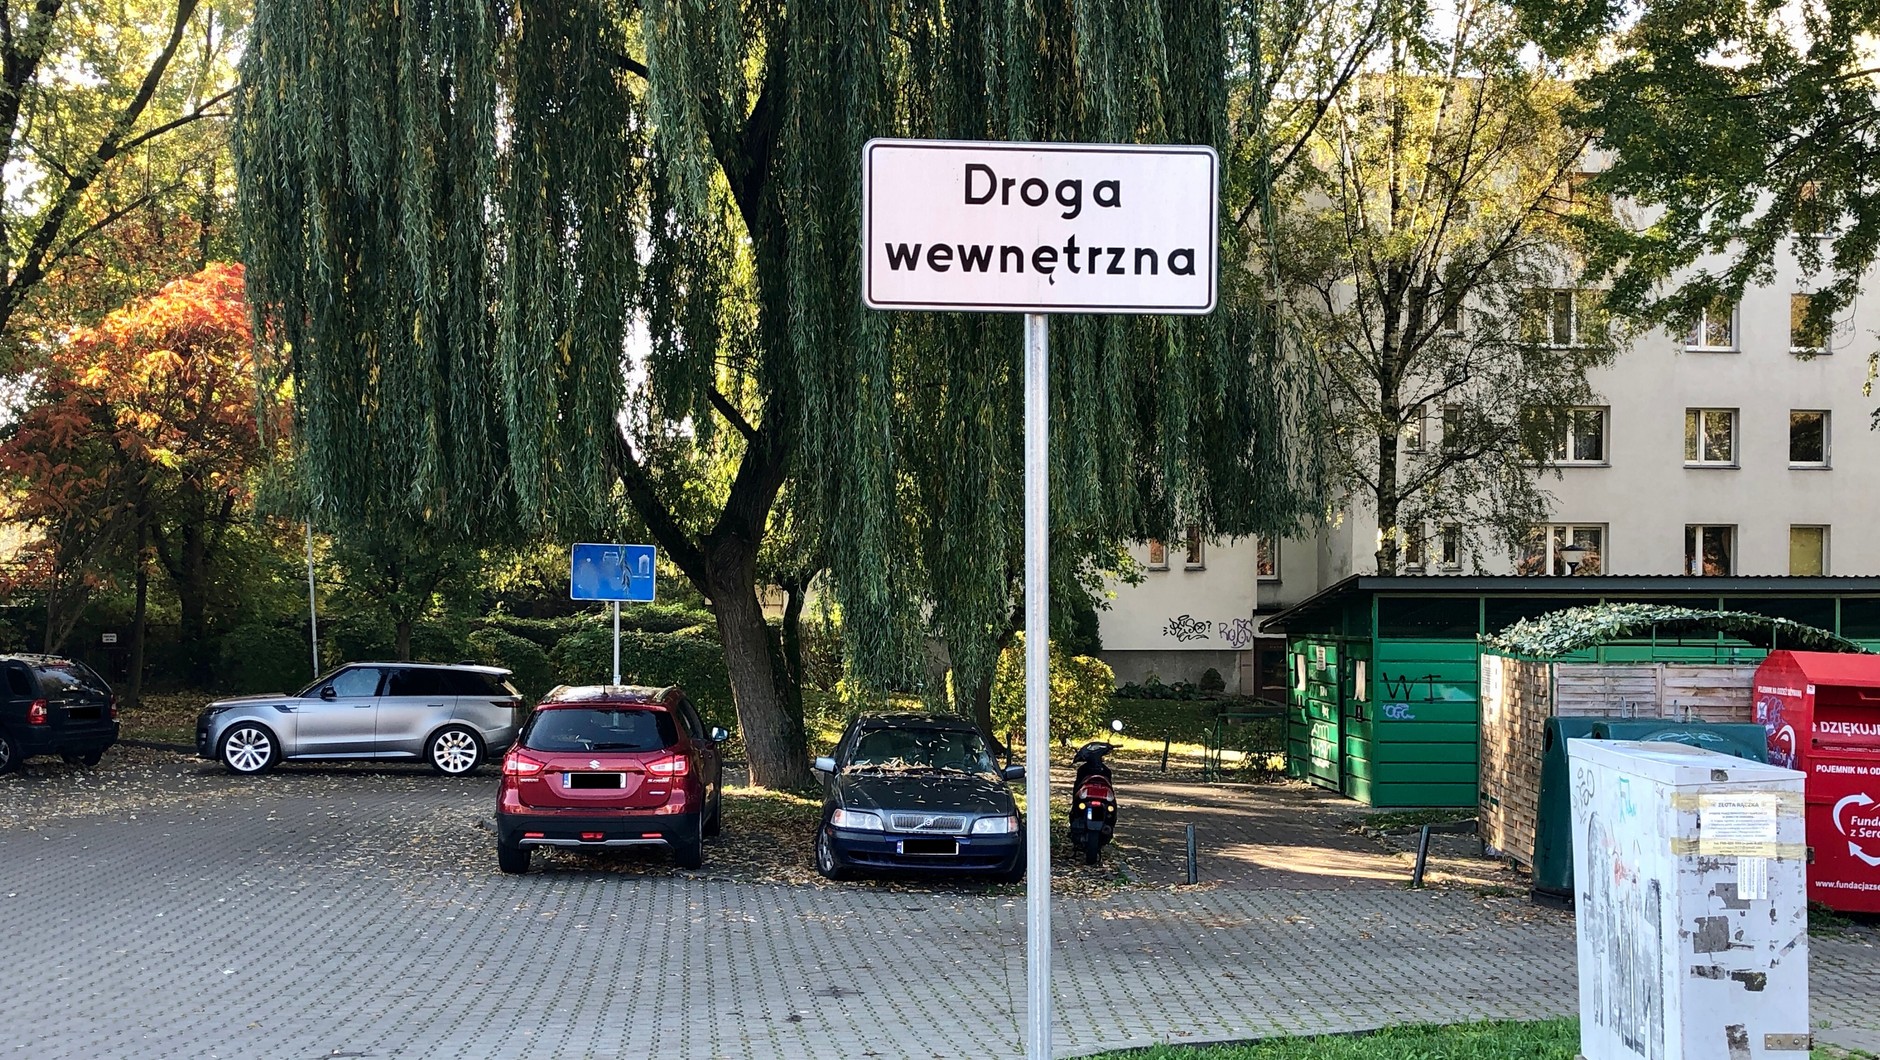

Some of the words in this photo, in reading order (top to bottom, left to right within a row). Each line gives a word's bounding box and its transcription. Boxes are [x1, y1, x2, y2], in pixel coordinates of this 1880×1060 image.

[965, 163, 1121, 219] Droga
[885, 233, 1196, 286] wewnętrzna
[1815, 764, 1856, 774] POJEMNIK
[1857, 766, 1868, 775] NA
[1850, 829, 1856, 837] z
